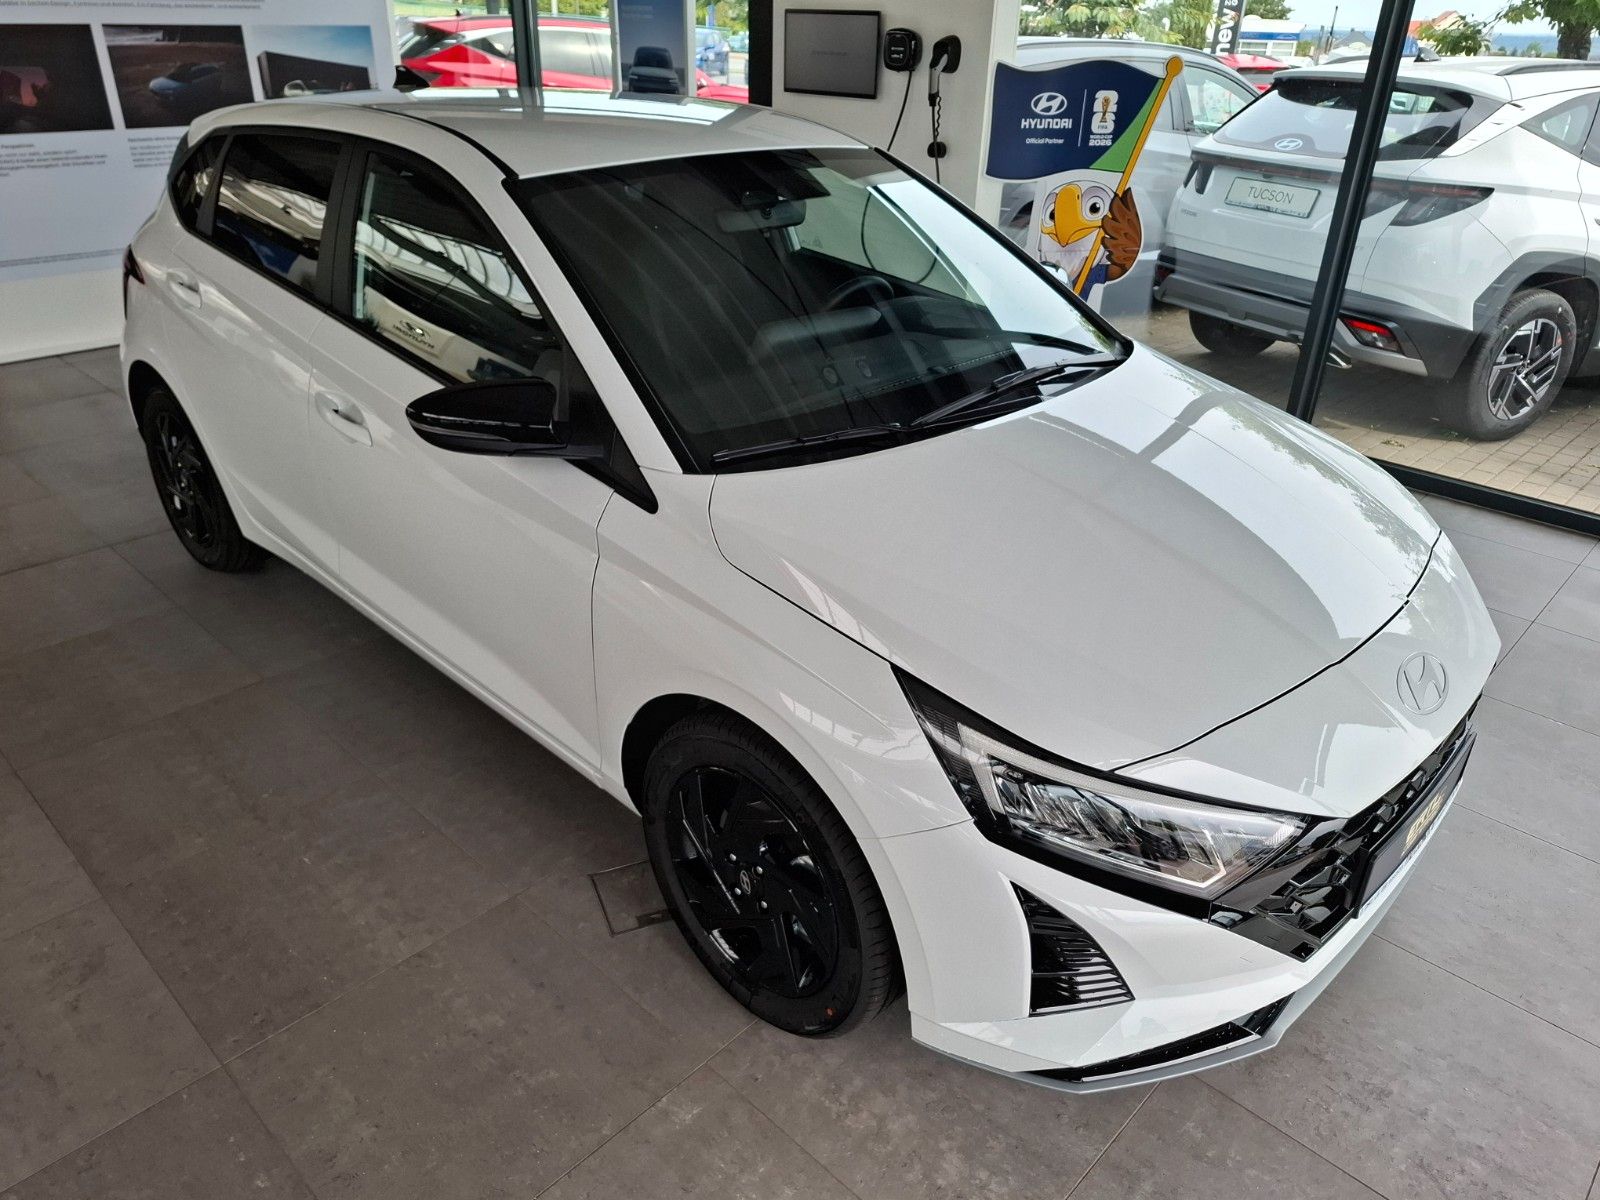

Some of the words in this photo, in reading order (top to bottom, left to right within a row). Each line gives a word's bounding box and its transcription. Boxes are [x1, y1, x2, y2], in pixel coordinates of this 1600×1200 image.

[1215, 8, 1239, 55] new
[1021, 118, 1073, 129] HYUNDAI
[1248, 186, 1295, 204] TUCSON
